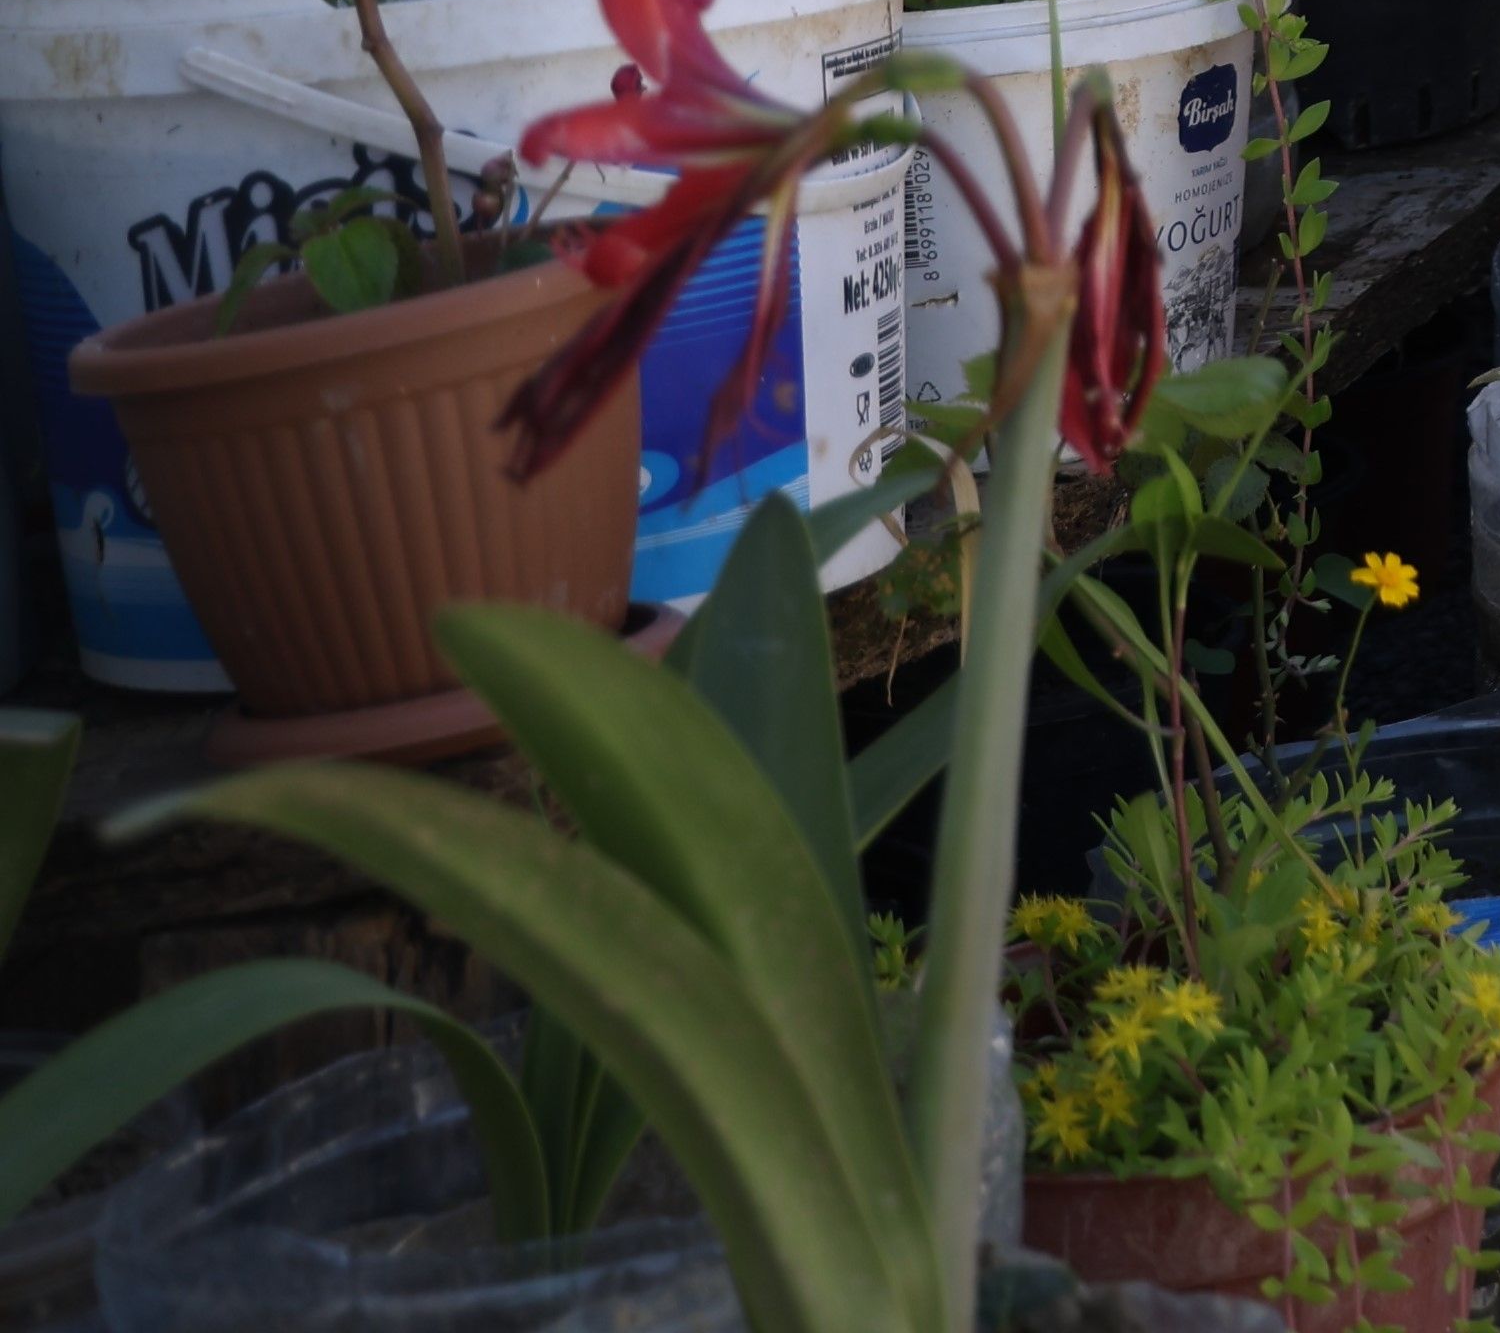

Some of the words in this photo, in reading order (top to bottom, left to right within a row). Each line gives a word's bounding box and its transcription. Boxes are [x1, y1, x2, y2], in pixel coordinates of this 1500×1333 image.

[1183, 90, 1235, 128] Birşah
[916, 193, 939, 261] 699118
[843, 271, 870, 315] Net:
[923, 270, 940, 281] 8
